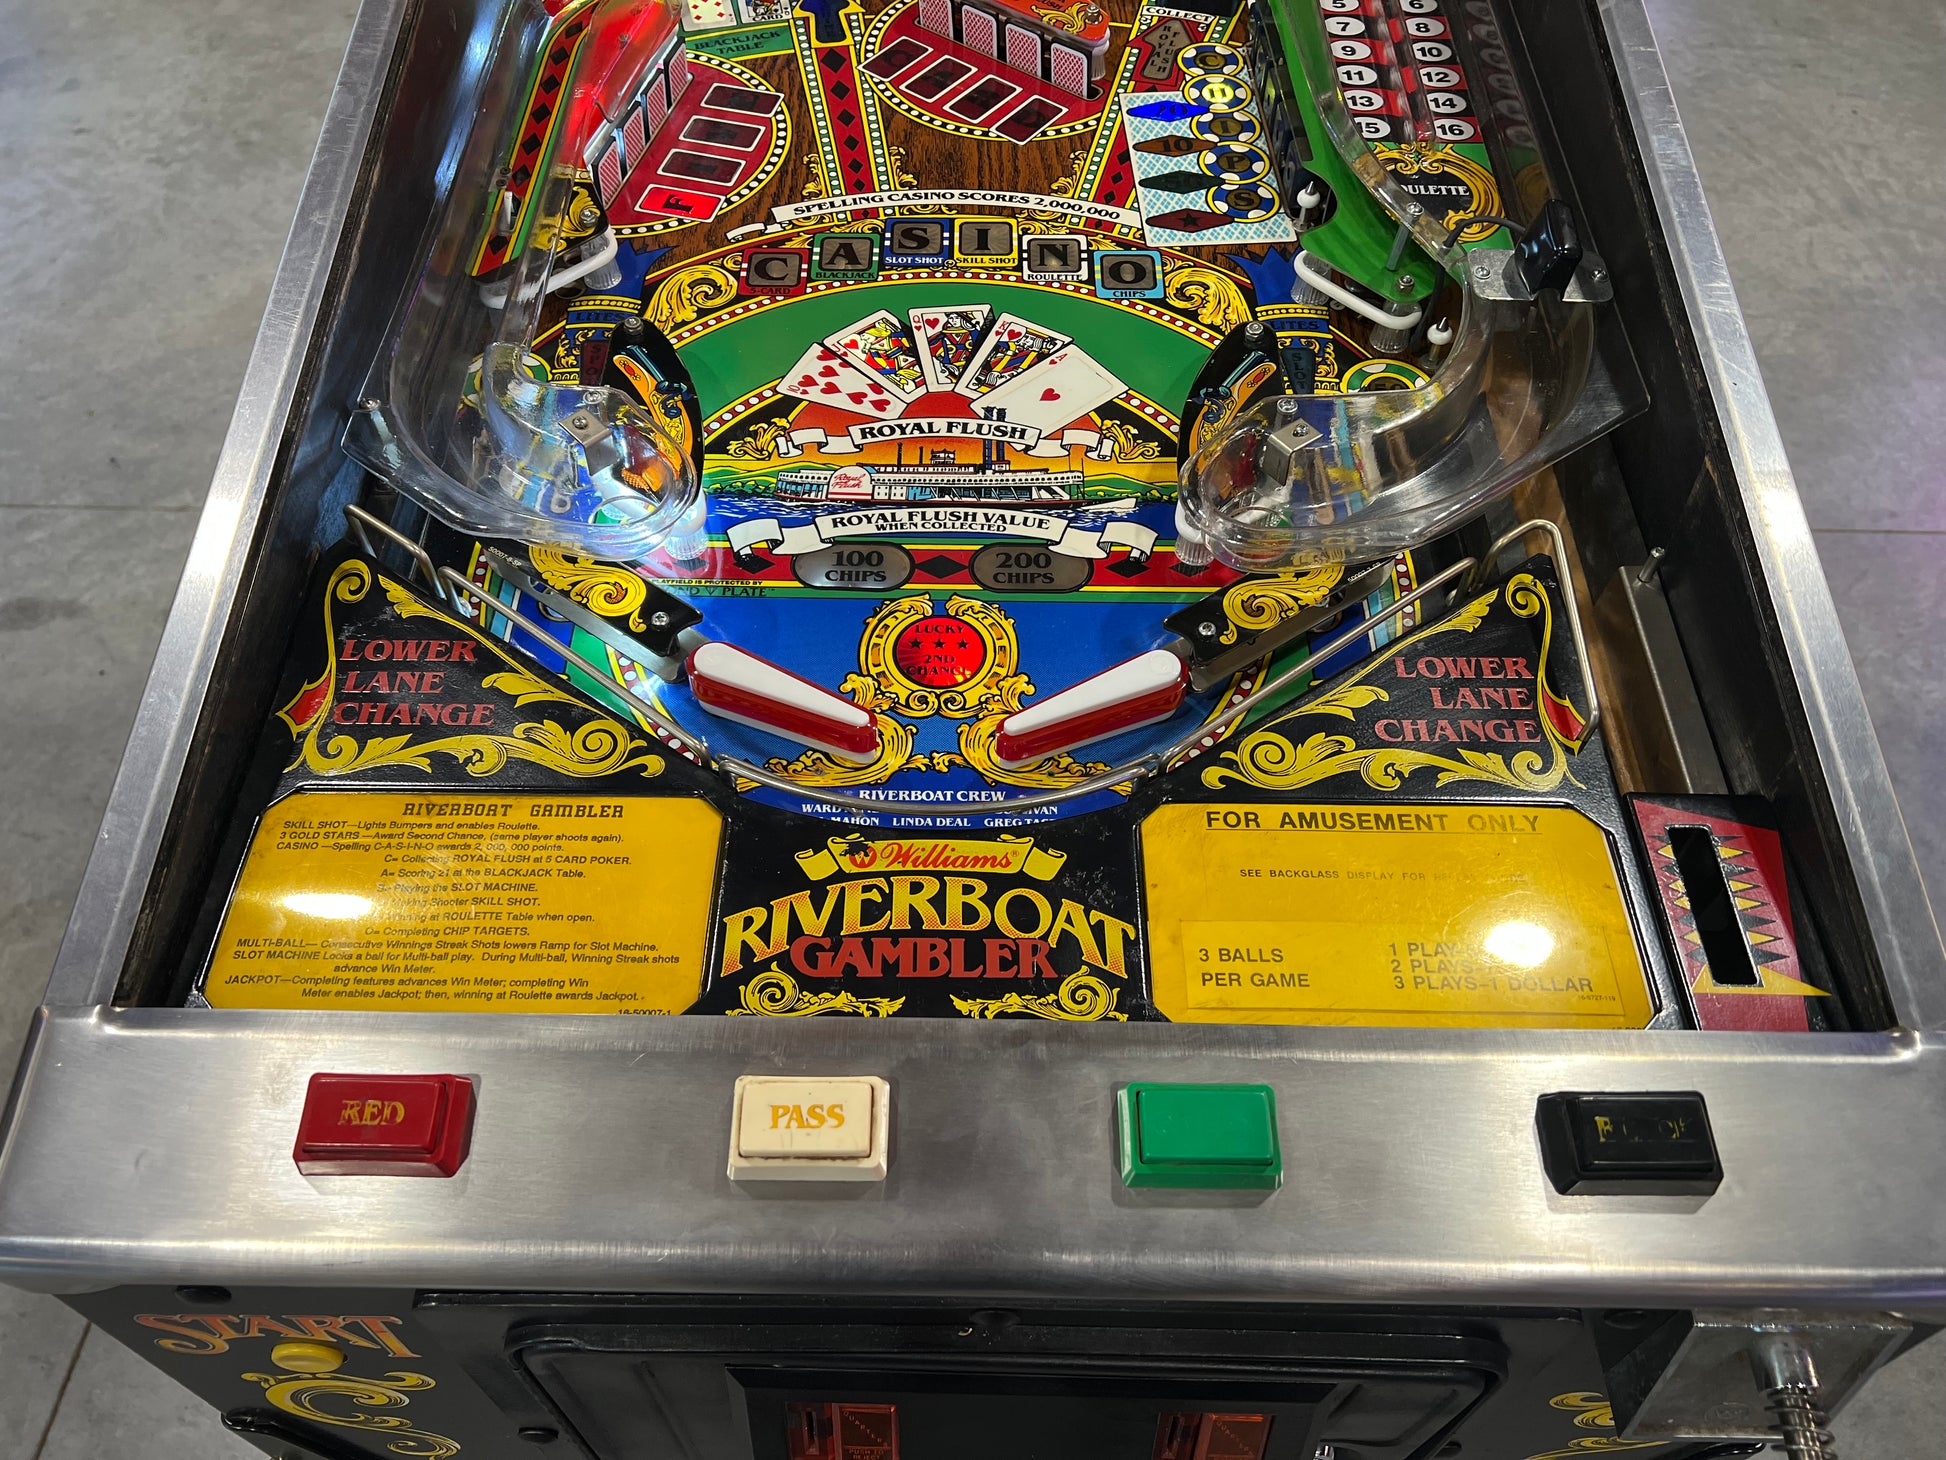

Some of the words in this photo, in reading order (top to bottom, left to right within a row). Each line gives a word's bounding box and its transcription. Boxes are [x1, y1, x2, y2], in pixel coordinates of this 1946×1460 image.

[1332, 0, 1346, 9] 5
[1410, 0, 1425, 9] 6
[1146, 7, 1211, 22] COLLECT
[1336, 22, 1350, 32] 7
[1415, 23, 1430, 33] 8
[694, 31, 781, 50] BLACKJACK
[716, 41, 764, 54] TABLE
[1340, 45, 1356, 56] 9
[1416, 46, 1442, 57] 10
[1341, 70, 1364, 81] 11
[1422, 71, 1449, 82] 12
[1346, 95, 1374, 107] 13
[1429, 97, 1457, 109] 14
[1356, 122, 1380, 135] 15
[1436, 123, 1464, 136] 16
[793, 191, 884, 216] SPELLING
[887, 189, 953, 203] CASINO
[957, 190, 1030, 205] SCORES
[1033, 197, 1121, 221] 2,000,000
[754, 257, 789, 281] C
[825, 242, 863, 265] A
[900, 227, 931, 251] S
[974, 228, 993, 251] I
[884, 256, 912, 264] SLOT
[914, 256, 944, 264] SHOT
[956, 256, 987, 264] SKILL
[988, 256, 1018, 264] SHOT
[815, 271, 875, 279] BLACKJACK
[1027, 273, 1082, 282] ROULETTE
[751, 287, 791, 295] 5-CARD
[1113, 290, 1146, 298] CHIPS
[912, 315, 921, 324] Q
[1000, 320, 1008, 331] K
[1271, 320, 1320, 330] LITES
[1057, 352, 1069, 362] A
[861, 421, 942, 440] ROYAL
[946, 421, 1028, 440] FLUSH
[833, 472, 864, 483] Royal
[831, 480, 863, 490] Flush
[832, 510, 903, 529] ROYAL
[907, 510, 980, 523] FLUSH
[982, 511, 1051, 530] VALUE
[875, 521, 919, 532] WHEN
[922, 521, 1007, 533] COLLECTED
[831, 550, 884, 567] 100
[995, 551, 1051, 569] 200
[824, 568, 887, 584] CHIPS
[995, 569, 1056, 585] CHIPS
[722, 587, 767, 597] PLATE
[915, 624, 964, 634] LUCKY
[339, 639, 478, 662] LOWER
[924, 654, 956, 664] 2ND
[1393, 656, 1535, 679] LOWER
[340, 671, 446, 693] LANE
[1429, 687, 1535, 710] LANE
[332, 702, 496, 726] CHANGE
[1373, 718, 1542, 743] CHANGE
[858, 789, 954, 802] RIVERBOAT
[955, 790, 1007, 802] CREW
[401, 803, 513, 818] RIVERBOAT
[529, 803, 625, 819] GAMBLER
[283, 820, 314, 830] SKILL
[389, 821, 432, 831] Bumpers
[435, 821, 452, 830] and
[456, 822, 494, 831] enables
[497, 822, 541, 831] Roulette.
[892, 817, 933, 827] LINDA
[935, 817, 971, 827] DEAL
[983, 817, 1023, 828] GREG
[1206, 811, 1261, 829] FOR
[1279, 811, 1448, 832] AMUSEMENT
[1467, 813, 1540, 833] ONLY
[289, 831, 320, 840] GOLD
[322, 831, 360, 840] STARS
[406, 832, 446, 841] Second
[449, 832, 487, 842] Chance,
[524, 833, 553, 843] player
[555, 833, 588, 842] shoots
[276, 841, 319, 851] CASINO
[532, 843, 564, 852] points.
[452, 854, 490, 864] ROYAL
[494, 854, 531, 864] FLUSH
[554, 855, 588, 864] CARD
[590, 855, 633, 865] POKER.
[880, 842, 1013, 869] Williams
[484, 868, 553, 878] BLACKJACK
[555, 868, 587, 879] Table.
[1240, 869, 1263, 878] SEE
[1269, 869, 1340, 879] BACKGLASS
[1347, 871, 1394, 881] DISPLAY
[451, 882, 483, 892] SLOT
[484, 882, 539, 892] MACHINE.
[471, 897, 504, 906] SKILL
[507, 897, 541, 907] SHOT.
[443, 911, 503, 921] ROULETTE
[506, 911, 534, 921] Table
[536, 912, 564, 921] when
[383, 927, 440, 938] Completing
[443, 927, 471, 936] CHIP
[474, 926, 531, 937] TARGETS.
[719, 875, 1137, 979] RIVERBOAT
[320, 939, 383, 949] Consecutive
[386, 939, 433, 951] Winnings
[435, 940, 468, 949] Streak
[470, 940, 501, 949] Shots
[503, 940, 537, 950] lowers
[539, 941, 570, 952] Ramp
[590, 941, 610, 951] Slot
[613, 942, 659, 951] Machine.
[232, 950, 263, 960] SLOT
[266, 950, 320, 960] MACHINE
[322, 951, 353, 960] Locks
[365, 951, 384, 961] ball
[402, 951, 449, 961] Multi-ball
[450, 952, 475, 963] play.
[481, 953, 516, 963] During
[518, 953, 568, 964] Multi-ball,
[571, 954, 613, 965] Winning
[615, 954, 649, 964] Streak
[651, 955, 681, 964] shots
[789, 935, 1059, 979] GAMBLER
[1199, 948, 1210, 962] 3
[1218, 948, 1284, 963] BALLS
[333, 964, 378, 973] advance
[381, 964, 401, 973] Win
[403, 965, 436, 974] Meter.
[1390, 959, 1402, 974] 2
[352, 975, 395, 986] features
[398, 976, 448, 986] advances
[450, 977, 470, 987] Win
[473, 977, 506, 988] Meter;
[508, 978, 565, 989] completing
[568, 978, 589, 988] Win
[1201, 972, 1242, 987] PER
[1250, 972, 1311, 988] GAME
[1394, 976, 1405, 990] 3
[1508, 976, 1594, 993] DOLLAR
[302, 988, 333, 998] Meter
[334, 989, 375, 998] enables
[377, 989, 422, 1001] Jackpot;
[453, 990, 494, 1001] winning
[509, 990, 551, 1001] Roulette
[555, 991, 594, 1001] awards
[595, 991, 639, 1002] Jackpot.
[337, 1099, 405, 1126] RED
[768, 1103, 845, 1129] PASS
[133, 1313, 422, 1358] START
